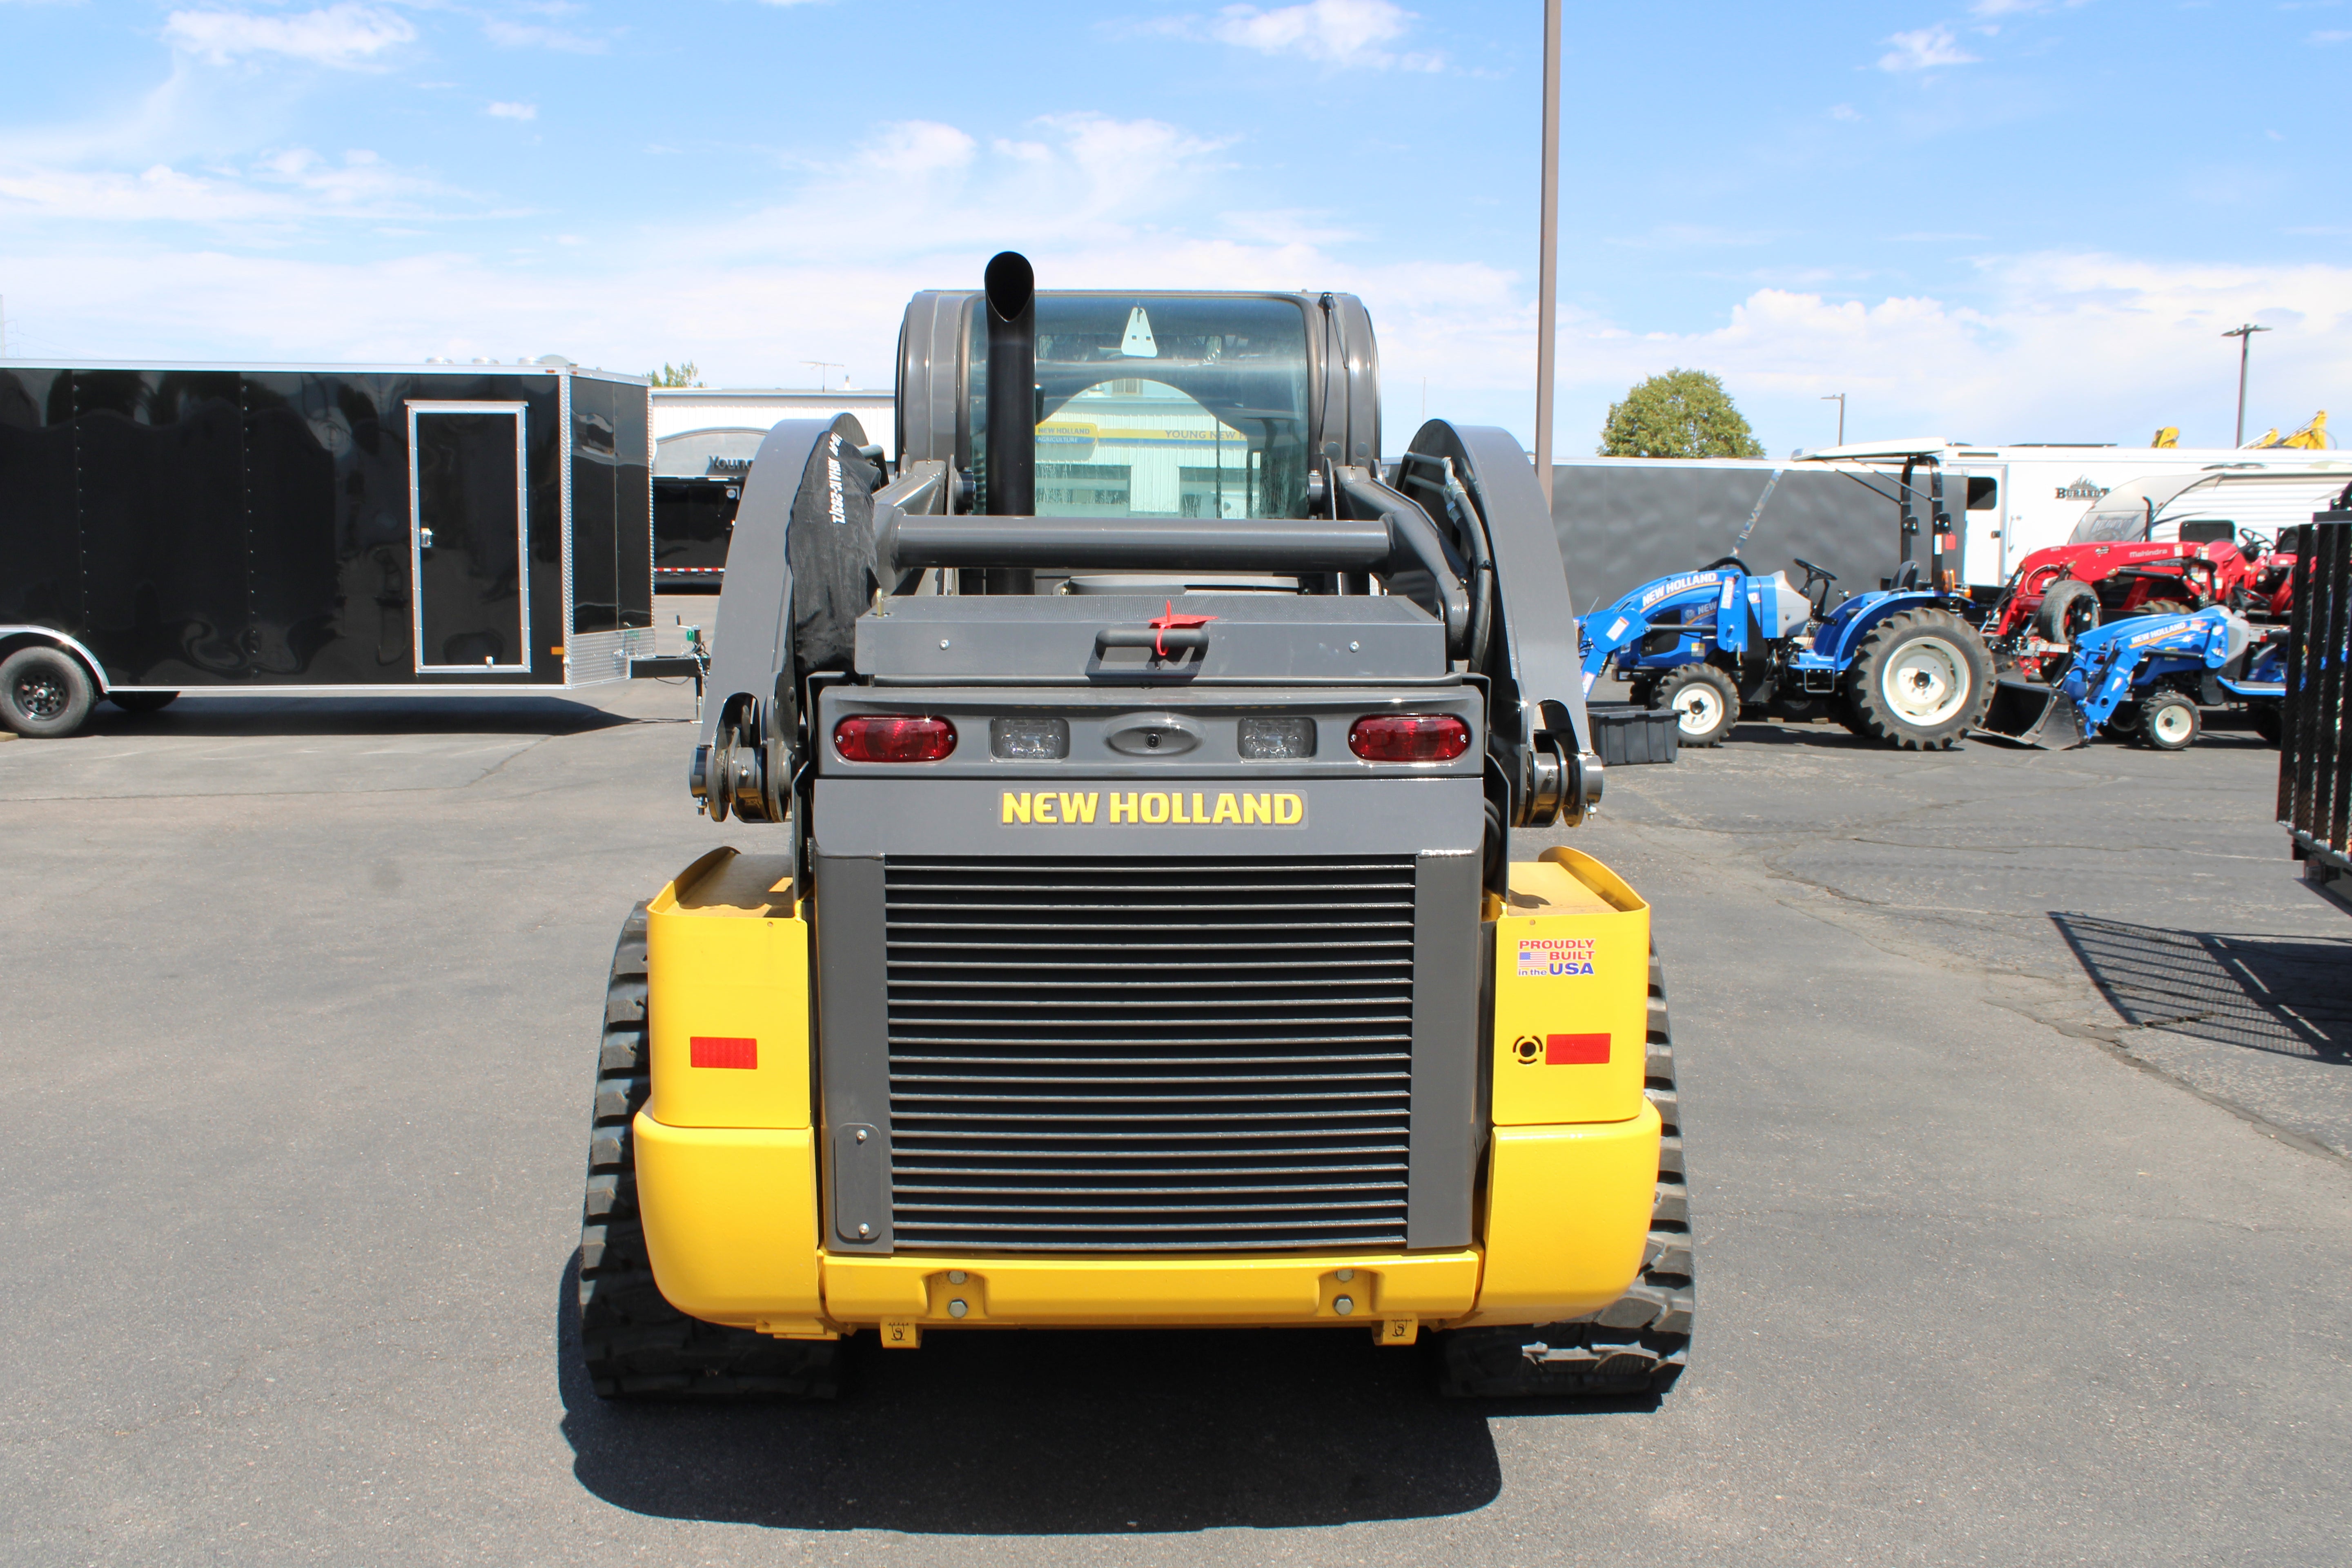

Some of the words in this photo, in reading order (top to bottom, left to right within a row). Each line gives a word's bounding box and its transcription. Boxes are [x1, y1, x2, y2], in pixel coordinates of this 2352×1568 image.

[1165, 430, 1206, 439] YOUNG
[1210, 431, 1236, 439] NEW
[1642, 586, 1665, 607] NEW
[1666, 572, 1717, 594] HOLLAND
[1698, 601, 1717, 615] NEW
[2131, 633, 2150, 644] NEW
[2150, 622, 2186, 637] HOLLAND
[1002, 793, 1099, 823] NEW
[1109, 793, 1303, 824] HOLLAND
[1519, 940, 1594, 949] PROUDLY
[1550, 951, 1595, 960] BUILT
[1549, 962, 1594, 975] USA
